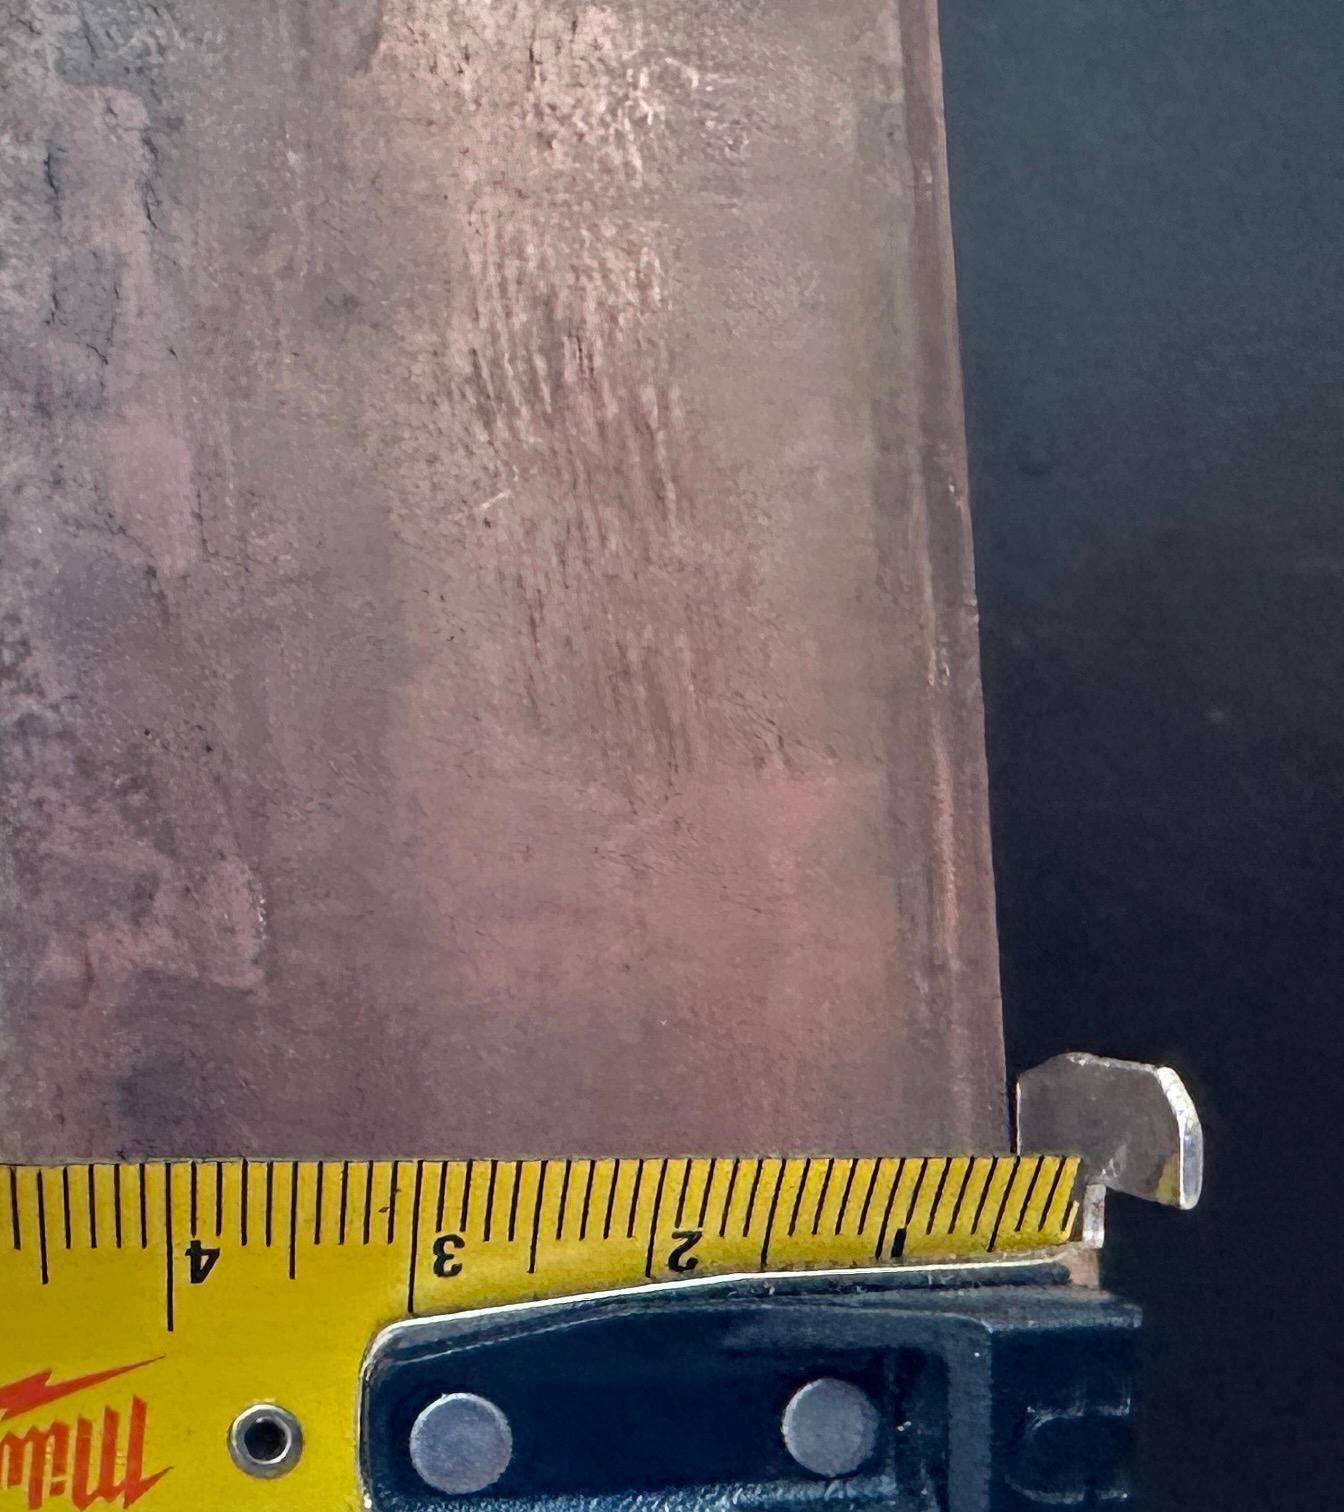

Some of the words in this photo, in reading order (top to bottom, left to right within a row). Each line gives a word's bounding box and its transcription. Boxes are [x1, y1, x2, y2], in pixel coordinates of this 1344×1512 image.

[186, 1239, 221, 1285] 4
[433, 1235, 463, 1278] 3
[667, 1231, 703, 1272] 2
